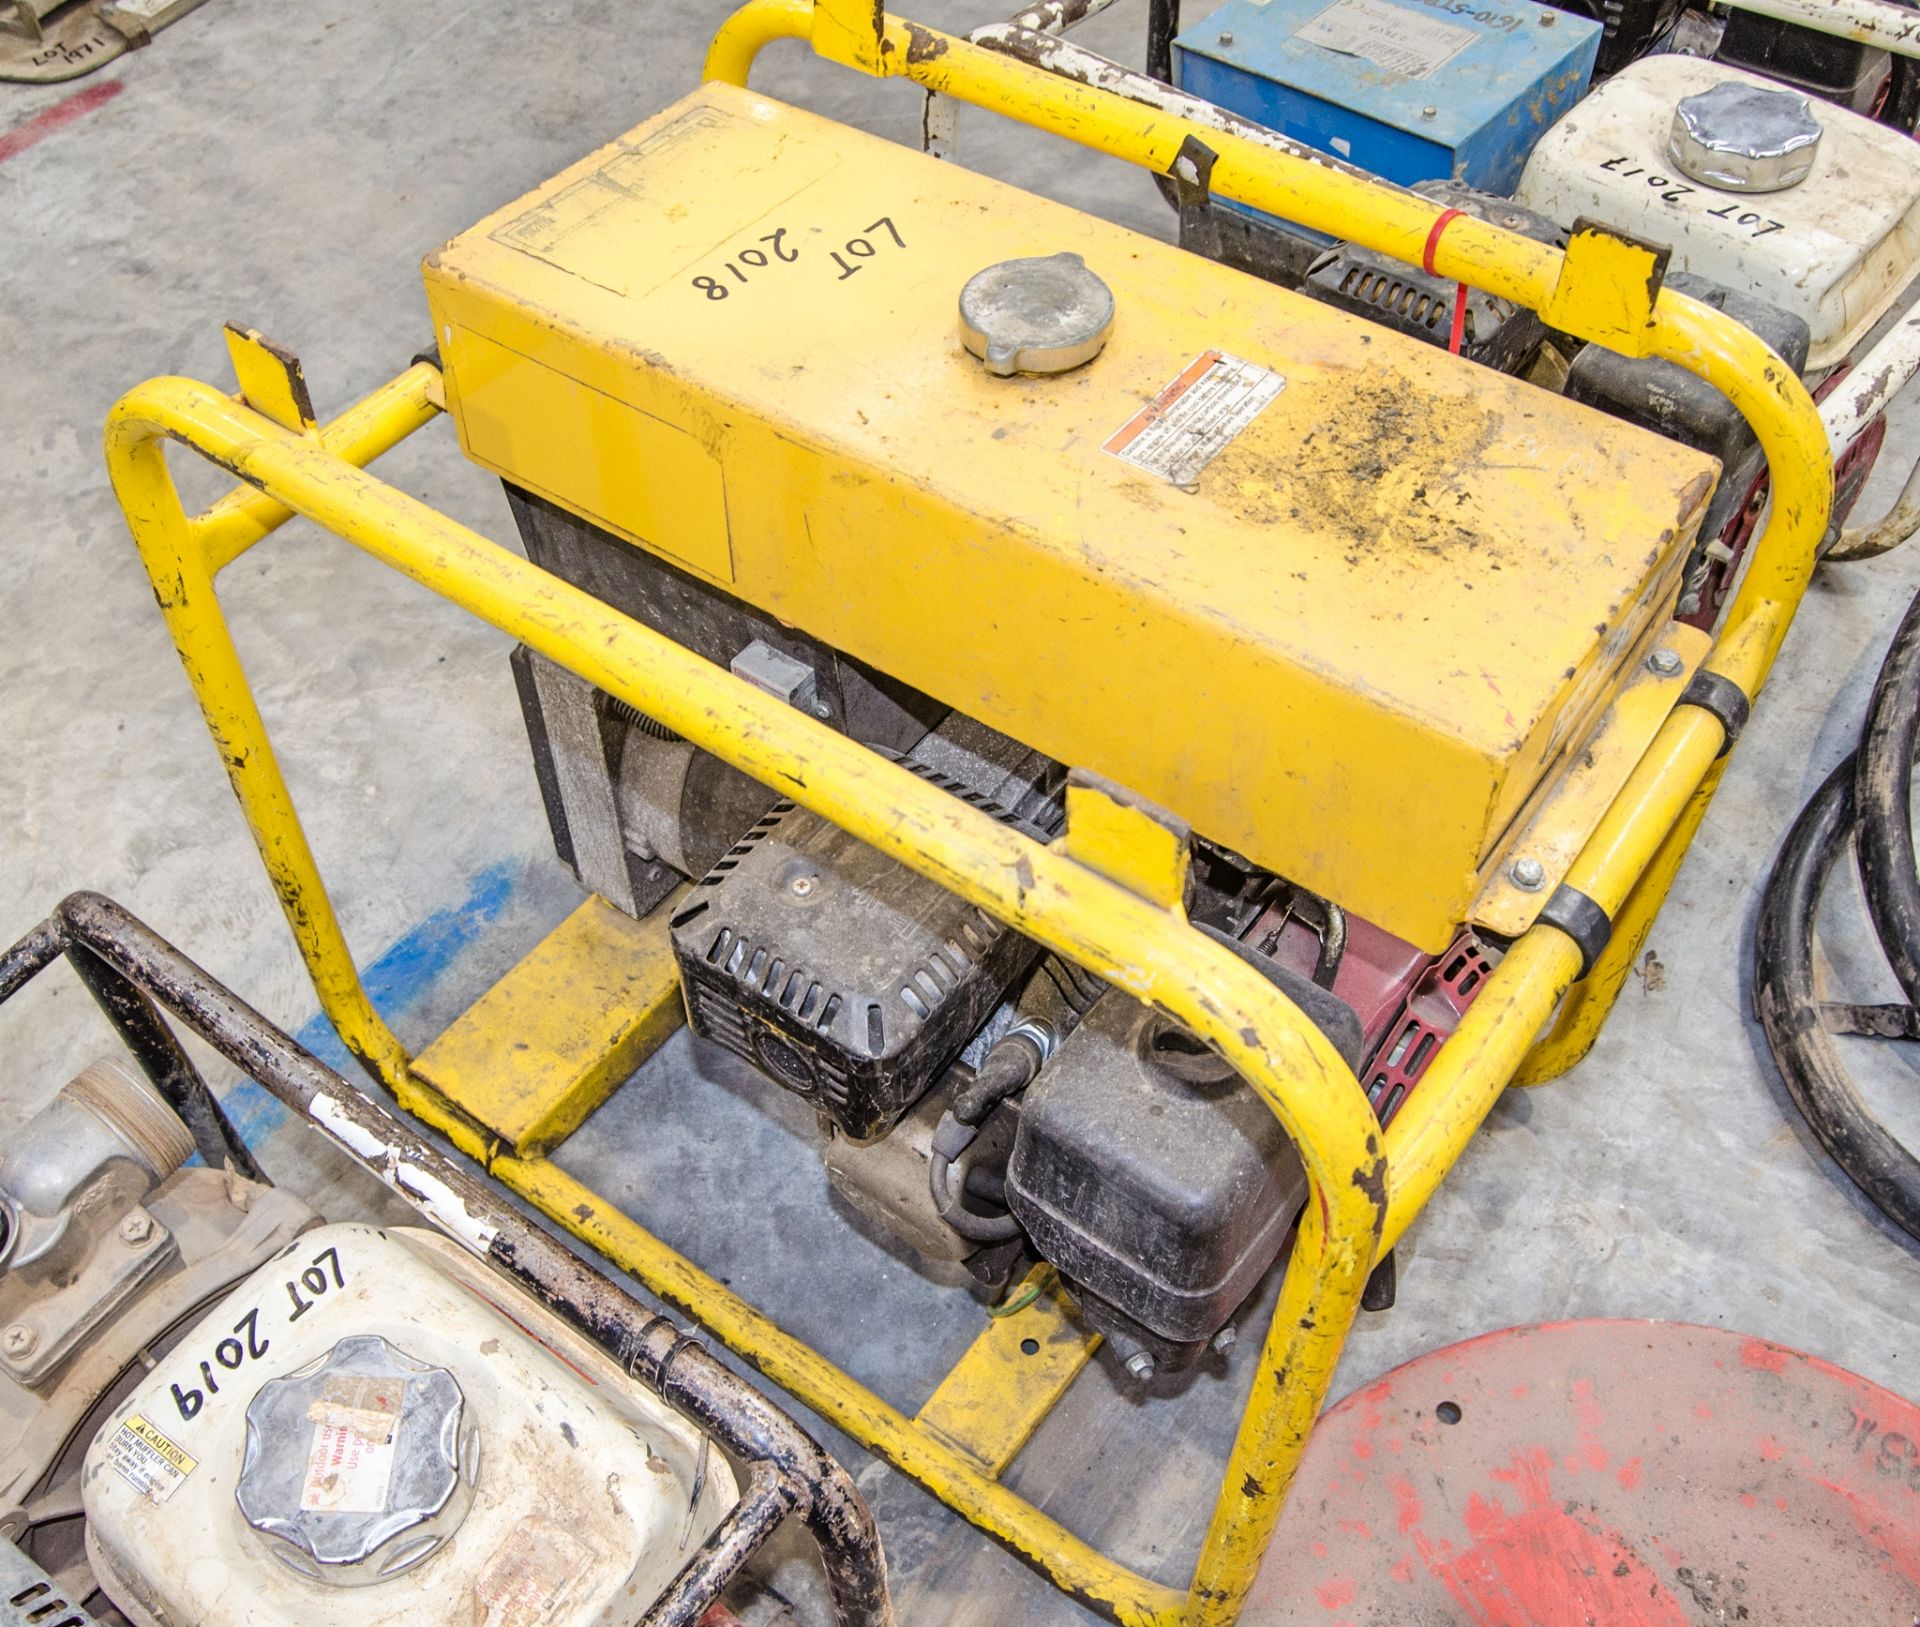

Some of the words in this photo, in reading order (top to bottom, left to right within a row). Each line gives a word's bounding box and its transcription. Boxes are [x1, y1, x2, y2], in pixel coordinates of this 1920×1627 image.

[32, 40, 69, 66] LOT
[63, 37, 105, 64] 1971
[1599, 156, 1695, 202] 2017
[1706, 204, 1785, 238] LOT
[691, 227, 799, 301] 2018
[829, 216, 907, 281] LOT
[286, 1247, 344, 1322] LOT
[170, 1308, 269, 1421] 2019
[114, 1434, 133, 1452] BURN
[133, 1450, 148, 1464] YOU
[120, 1428, 135, 1441] HOT
[134, 1439, 165, 1466] MUFFLER
[163, 1463, 179, 1478] CAN
[145, 1430, 186, 1465] CAUTION
[346, 1448, 359, 1469] Use
[122, 1455, 138, 1469] away
[144, 1472, 165, 1492] engine
